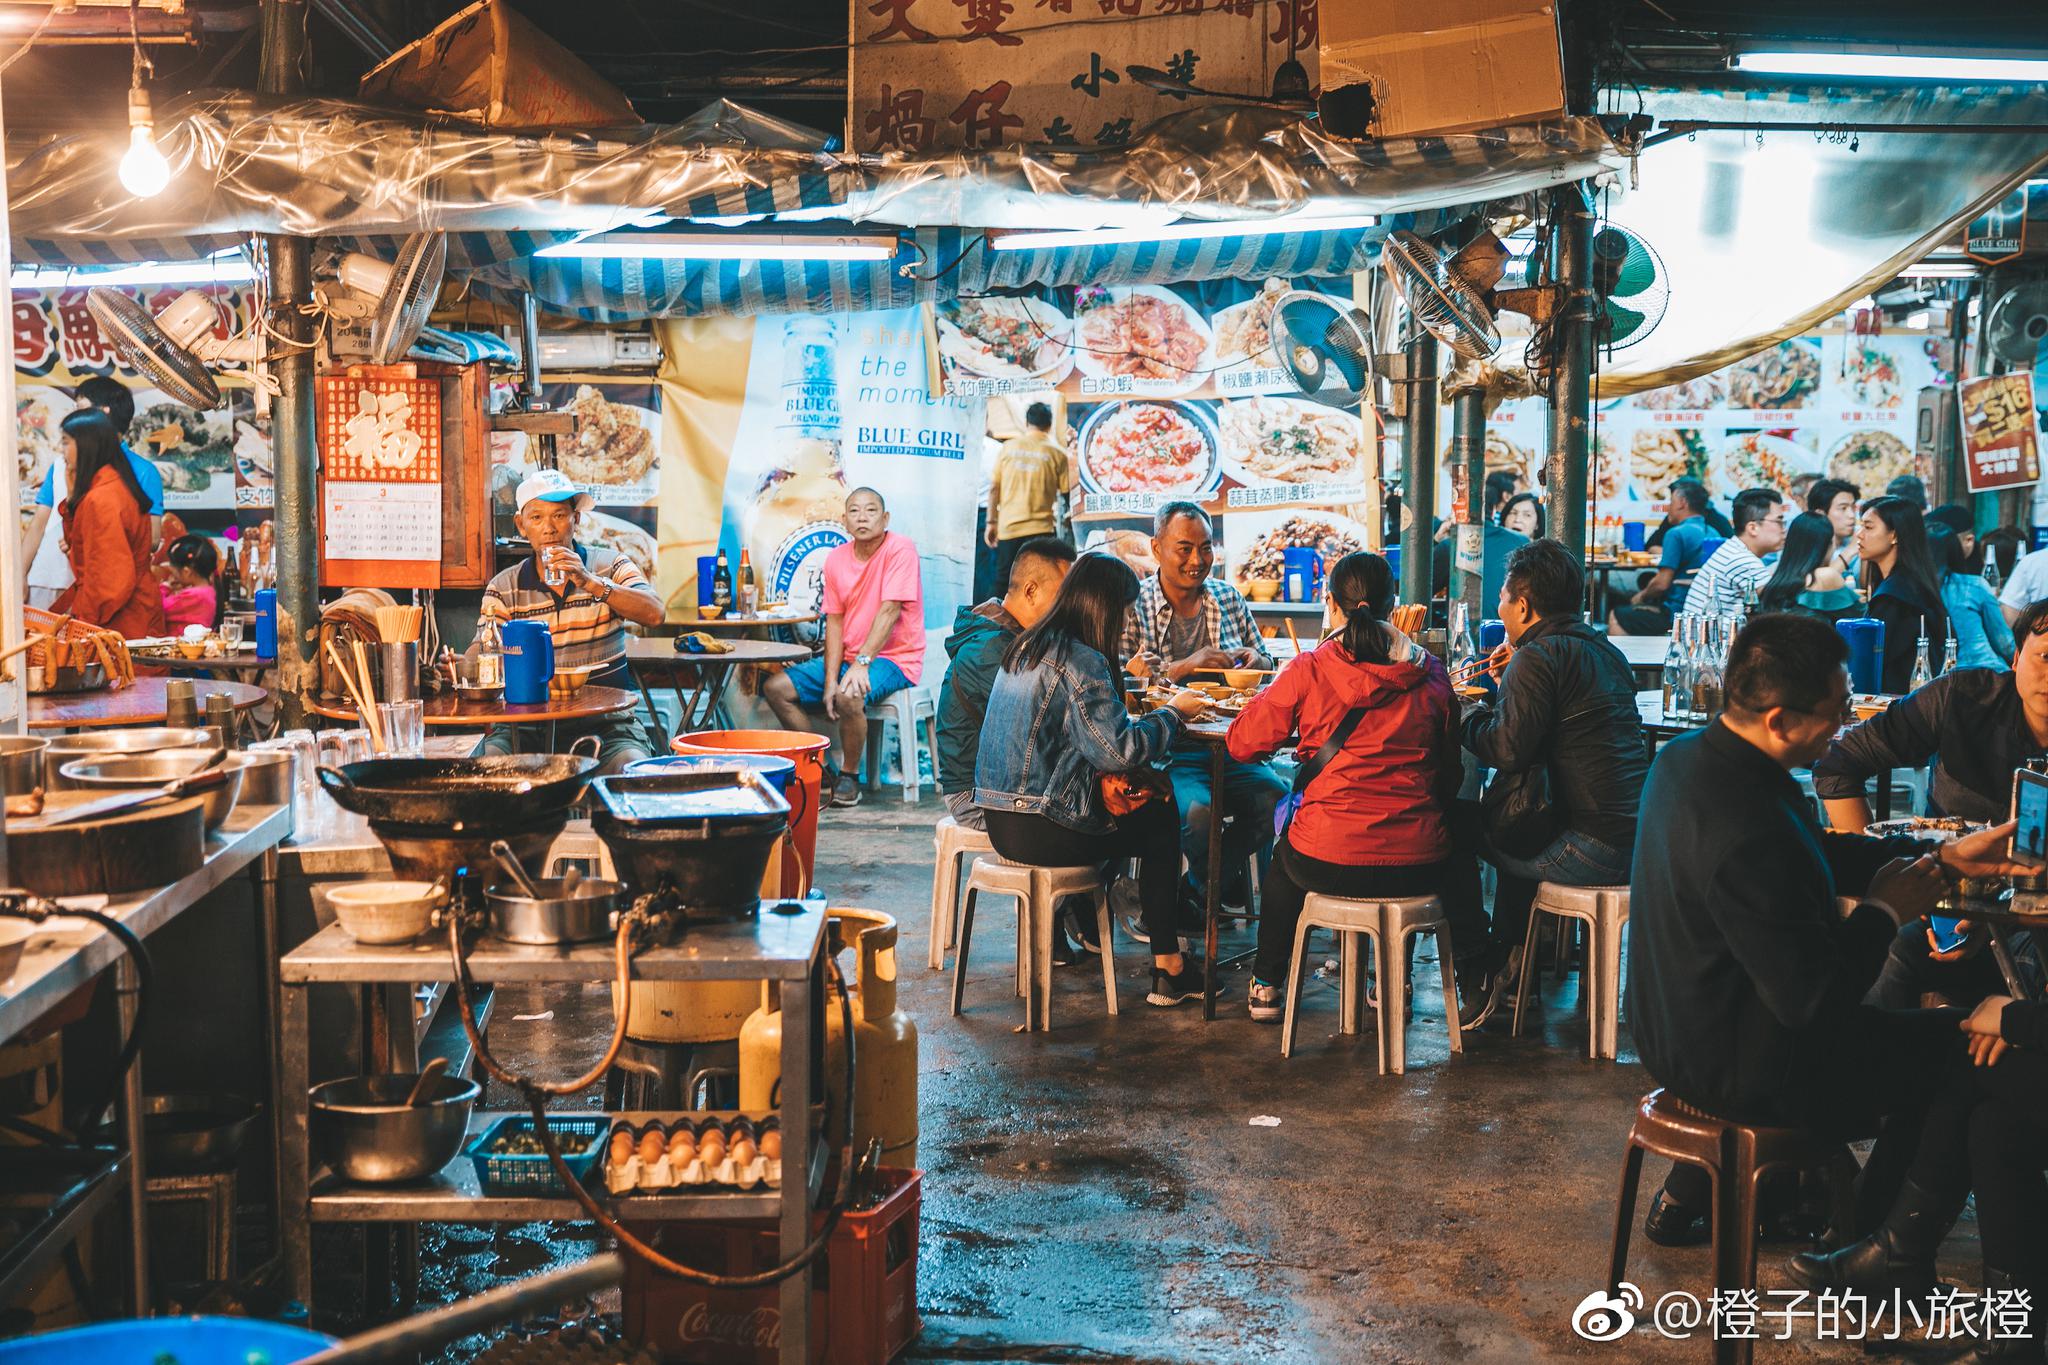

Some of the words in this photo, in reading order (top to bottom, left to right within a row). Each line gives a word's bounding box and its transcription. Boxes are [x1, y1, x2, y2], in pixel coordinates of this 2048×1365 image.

[1970, 239, 1994, 247] BLUE
[1996, 239, 2018, 247] GIRL
[863, 325, 924, 346] shar
[860, 355, 907, 377] the
[945, 379, 1012, 397] 支竹鯉魚
[1082, 374, 1133, 393] 白灼蝦
[787, 398, 825, 411] BLUE
[344, 389, 422, 470] 福
[858, 427, 911, 444] BLUE
[918, 429, 965, 449] GIRL
[780, 535, 822, 586] PILSENER
